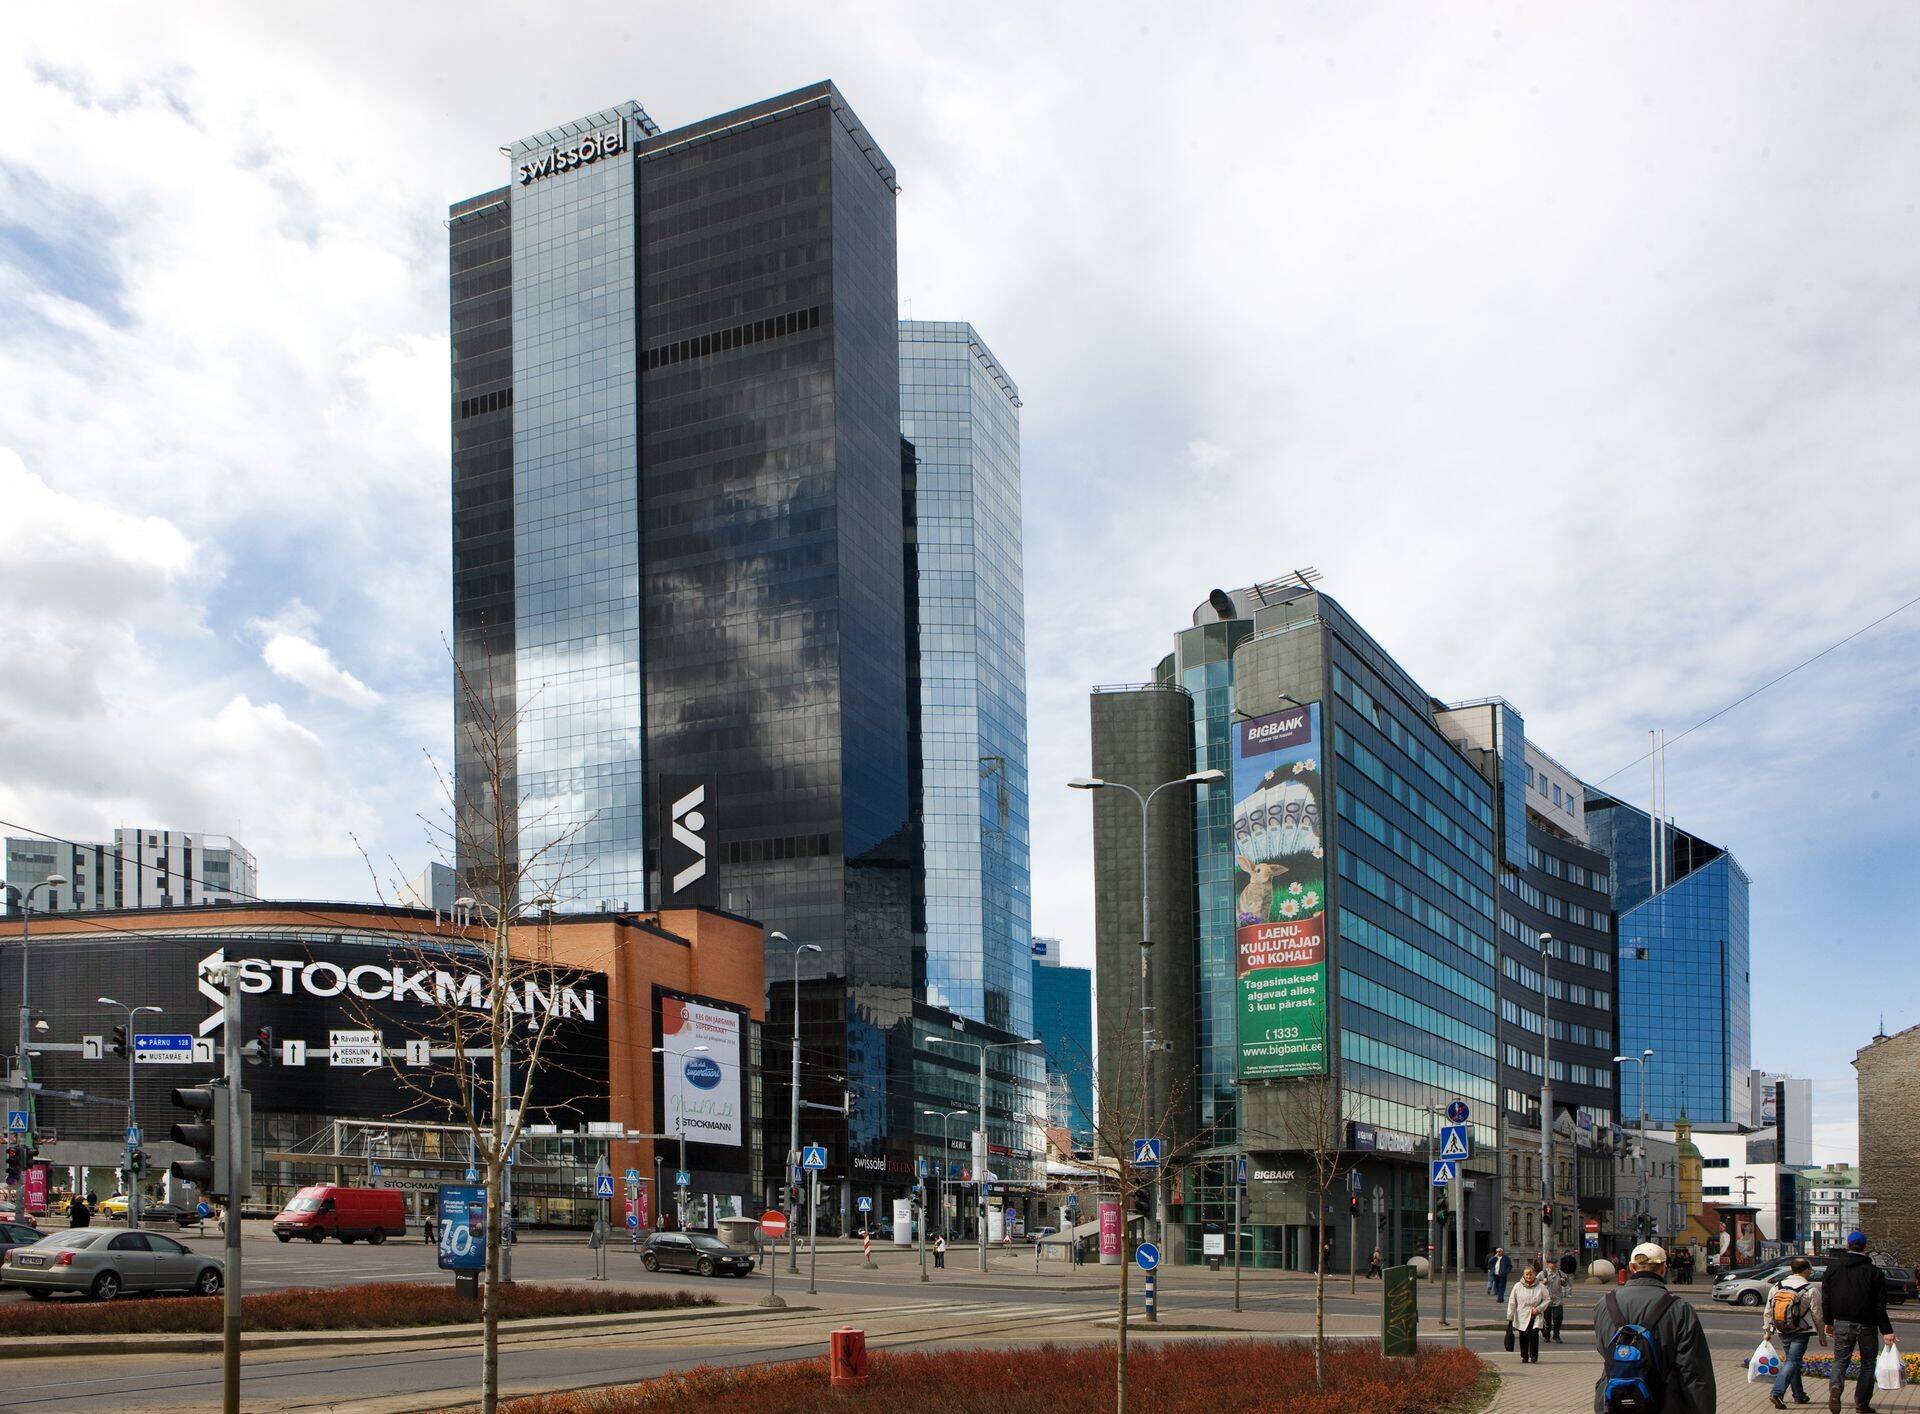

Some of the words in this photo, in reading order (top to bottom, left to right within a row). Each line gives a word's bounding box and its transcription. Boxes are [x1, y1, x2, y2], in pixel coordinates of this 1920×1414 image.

[1248, 716, 1303, 740] BIGBANK
[1258, 925, 1302, 940] LAENU-
[1240, 935, 1320, 954] KUULUTAJAD
[1247, 955, 1265, 966] ON
[1268, 948, 1313, 963] KOHAL!
[1244, 972, 1319, 989] Tagasimaksed
[240, 958, 594, 1021] STOCKMANN
[1247, 988, 1287, 1002] algavad
[1290, 985, 1316, 996] alles
[1248, 1003, 1254, 1012] 3
[1257, 1001, 1276, 1011] kuu
[1279, 998, 1316, 1011] pärast.
[1273, 1027, 1299, 1039] 1333
[149, 1038, 171, 1046] PÄRNU
[1243, 1042, 1323, 1057] www.bigbank.ee
[682, 1118, 732, 1131] STOCKMANN
[1254, 1170, 1295, 1179] BIGBANK
[384, 1181, 440, 1189] STOCKMAN
[441, 1219, 472, 1257] 10
